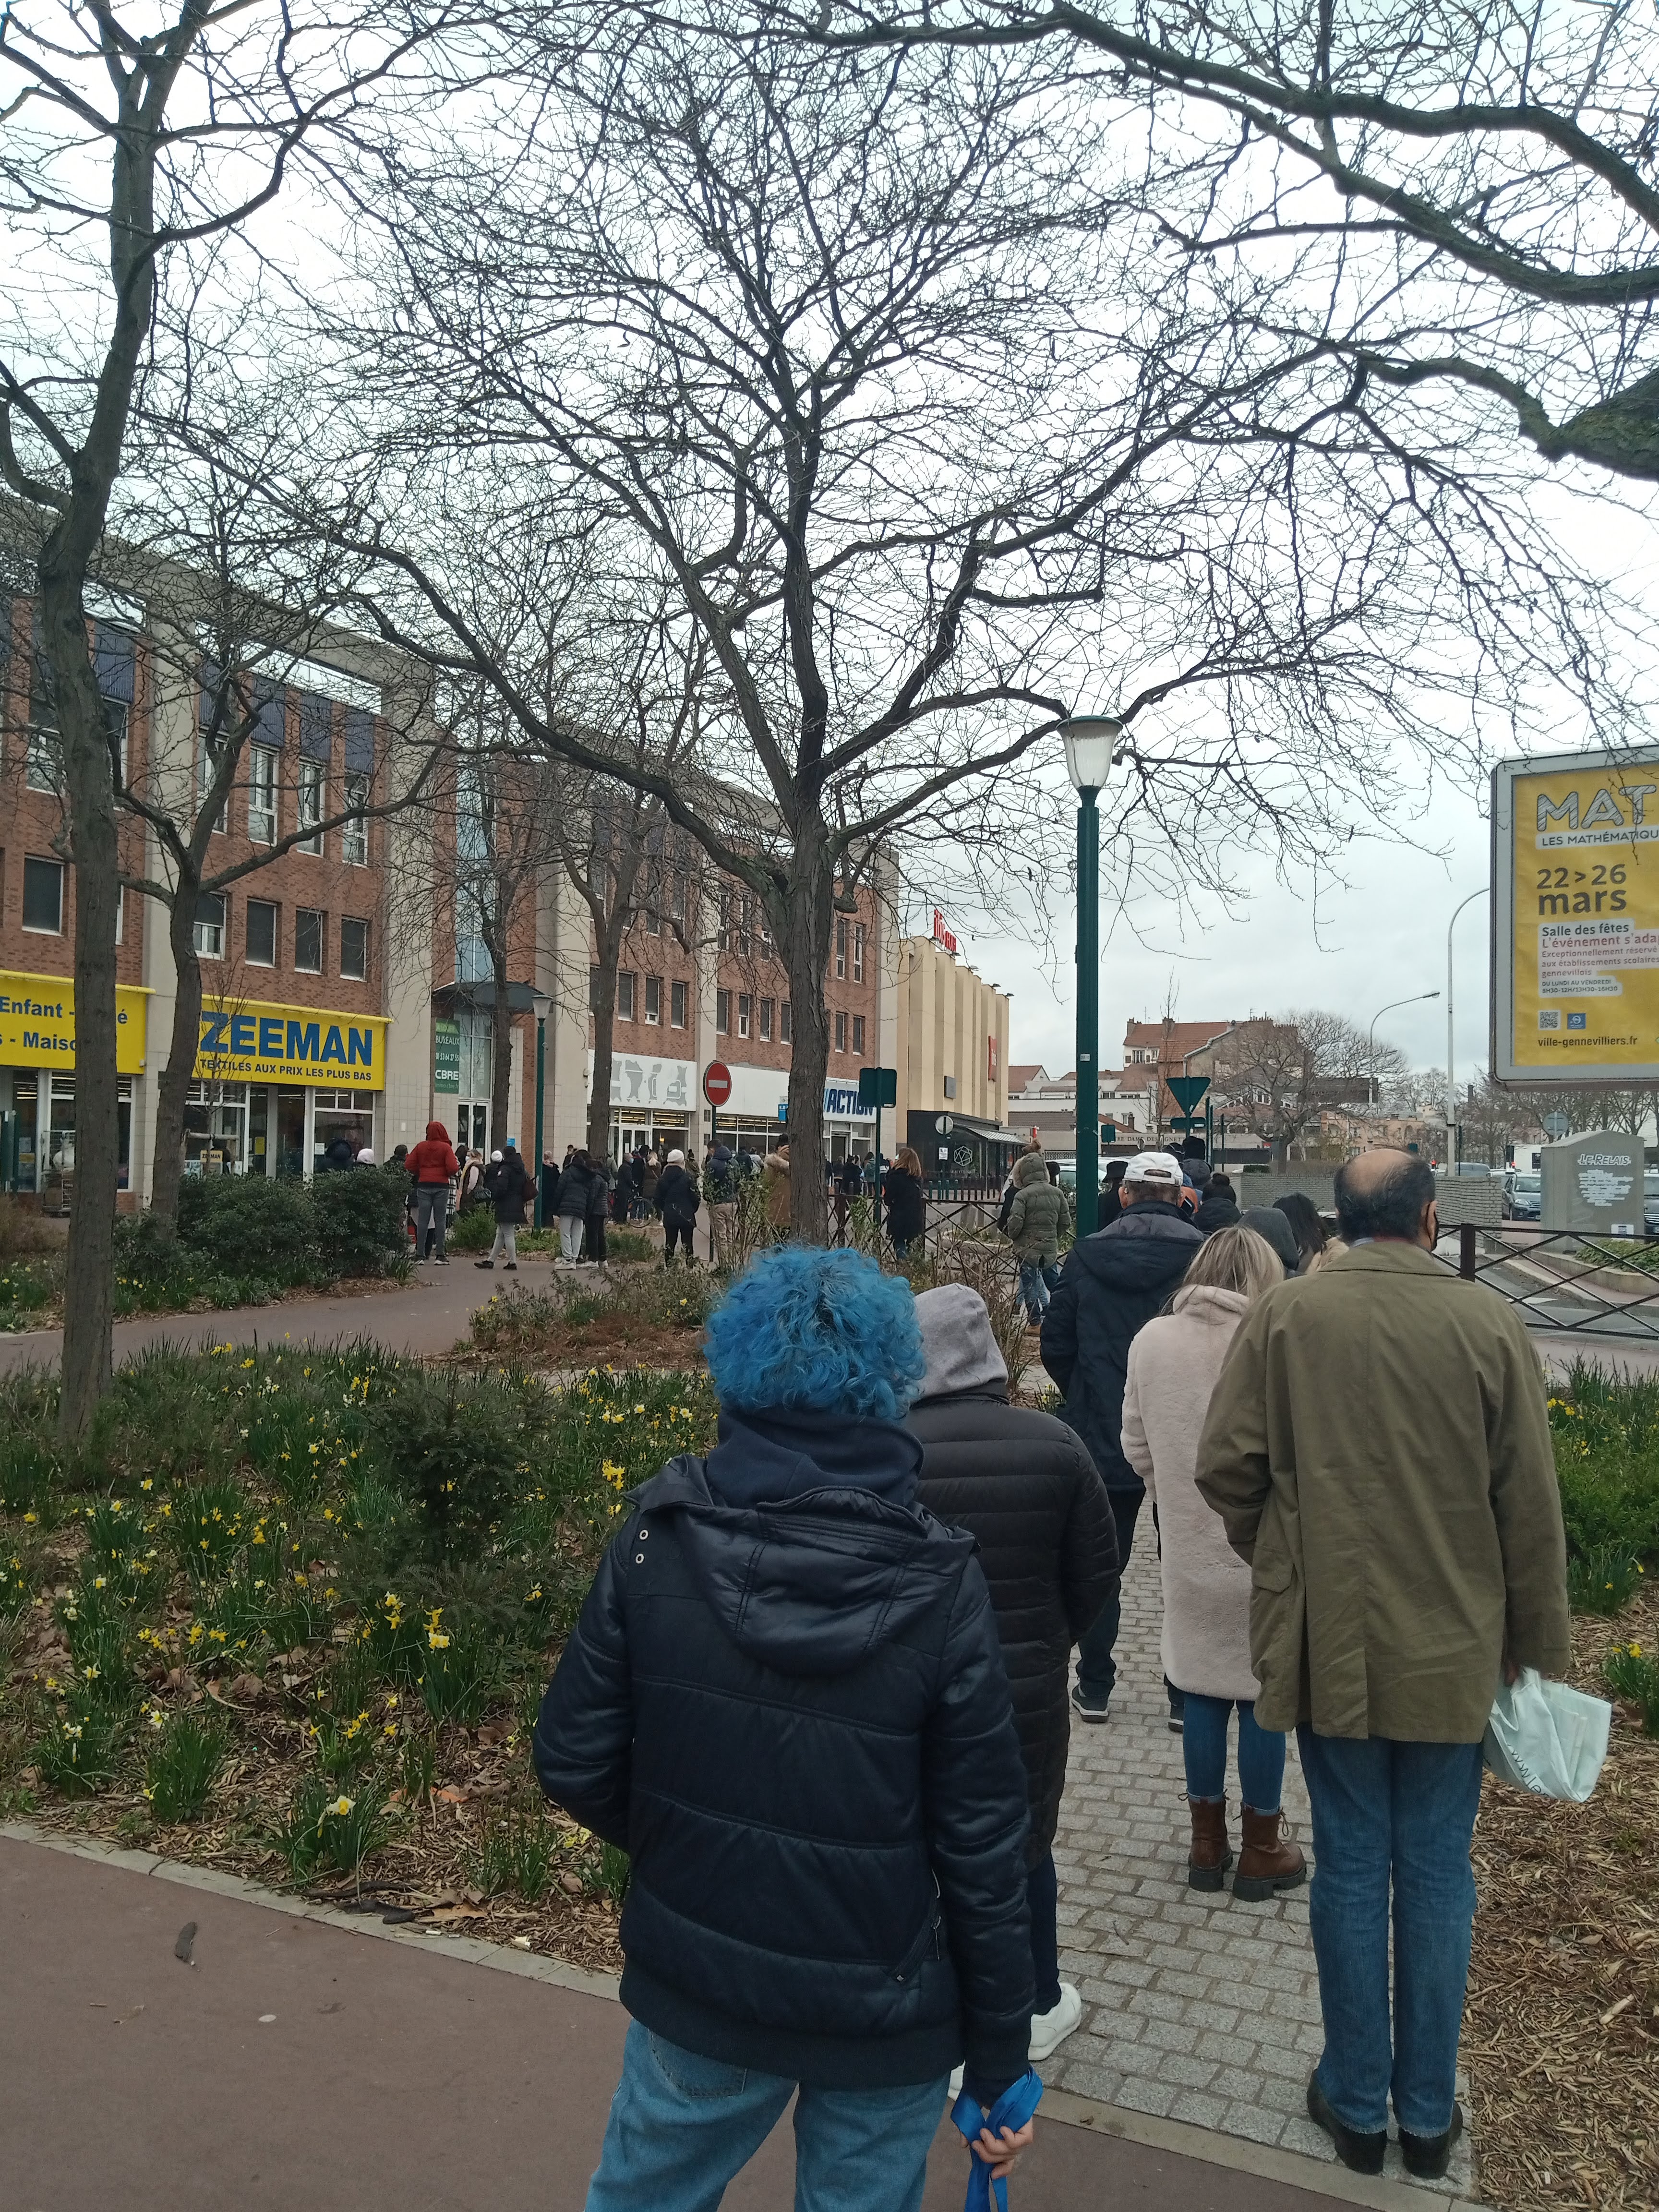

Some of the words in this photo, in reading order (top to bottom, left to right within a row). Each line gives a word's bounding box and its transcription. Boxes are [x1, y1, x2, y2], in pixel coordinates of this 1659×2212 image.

[1537, 784, 1657, 832] MAT
[1542, 836, 1563, 846] LES
[1568, 830, 1659, 845] MATHÉMATIQU
[1539, 890, 1627, 915] mars
[1542, 926, 1571, 937] Salle
[1575, 925, 1596, 935] des
[1599, 923, 1629, 934] fêtes
[1542, 936, 1621, 948] L'événement
[1624, 933, 1659, 945] s'ada
[1541, 949, 1623, 959] Exceptionnellement
[1626, 946, 1657, 954] réservé
[1559, 958, 1621, 967] établissements
[1623, 956, 1659, 964] scolaires
[1541, 970, 1592, 979] gennevillois
[0, 996, 63, 1018] Enfant
[23, 1032, 76, 1051] Maiso
[200, 1011, 373, 1066] ZEEMAN
[435, 1035, 460, 1046] BUREAUX
[1538, 1036, 1638, 1048] ville-gennevilliers.fr
[200, 1058, 252, 1071] TEXTILES
[255, 1063, 276, 1074] AUX
[279, 1065, 303, 1076] PRIX
[306, 1068, 324, 1078] LES
[326, 1069, 350, 1079] PLUS
[353, 1071, 372, 1081] BAS
[435, 1069, 459, 1081] CBRE
[1579, 1154, 1594, 1165] LE
[1594, 1154, 1629, 1165] RELAIS
